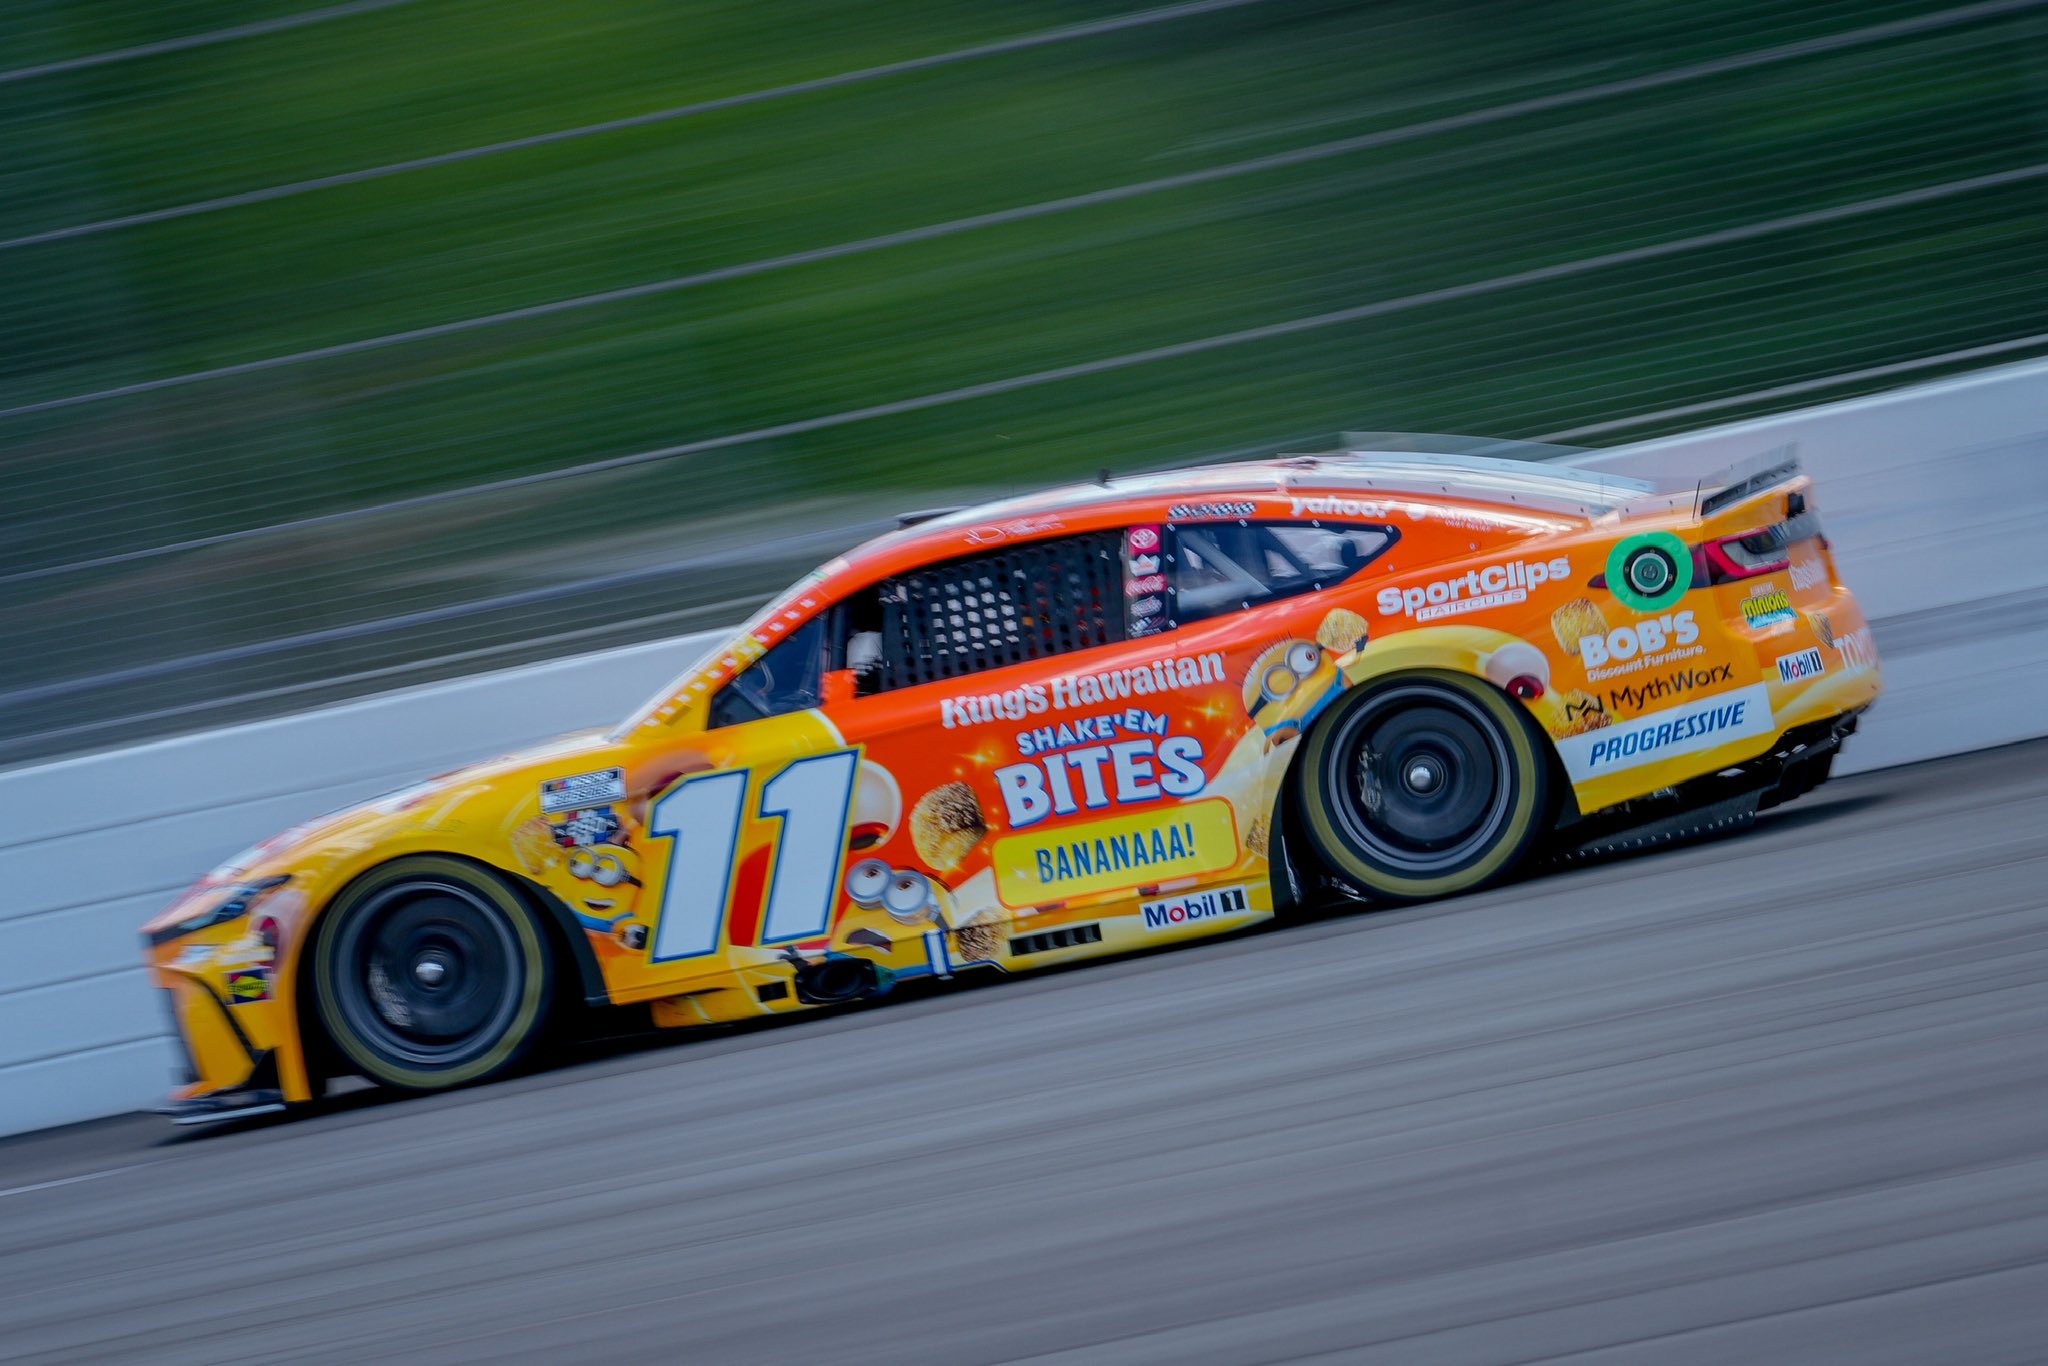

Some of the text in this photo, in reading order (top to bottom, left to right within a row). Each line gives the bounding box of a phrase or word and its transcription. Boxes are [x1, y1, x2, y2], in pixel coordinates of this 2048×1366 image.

[1376, 557, 1571, 617] SportClips
[1419, 591, 1523, 620] HAIRCUTS
[1579, 610, 1700, 669] BOB'S
[1778, 654, 1813, 683] Mobil
[940, 651, 1227, 729] King's Hawaiian
[1586, 657, 1644, 684] Discount
[1610, 662, 1734, 710] MythWorx
[1588, 700, 1747, 767] PROGRESSIVE
[994, 736, 1207, 828] BITES
[650, 748, 860, 964] 11
[1036, 822, 1196, 883] BANANAAA!
[1143, 889, 1244, 928] Mobil 1
